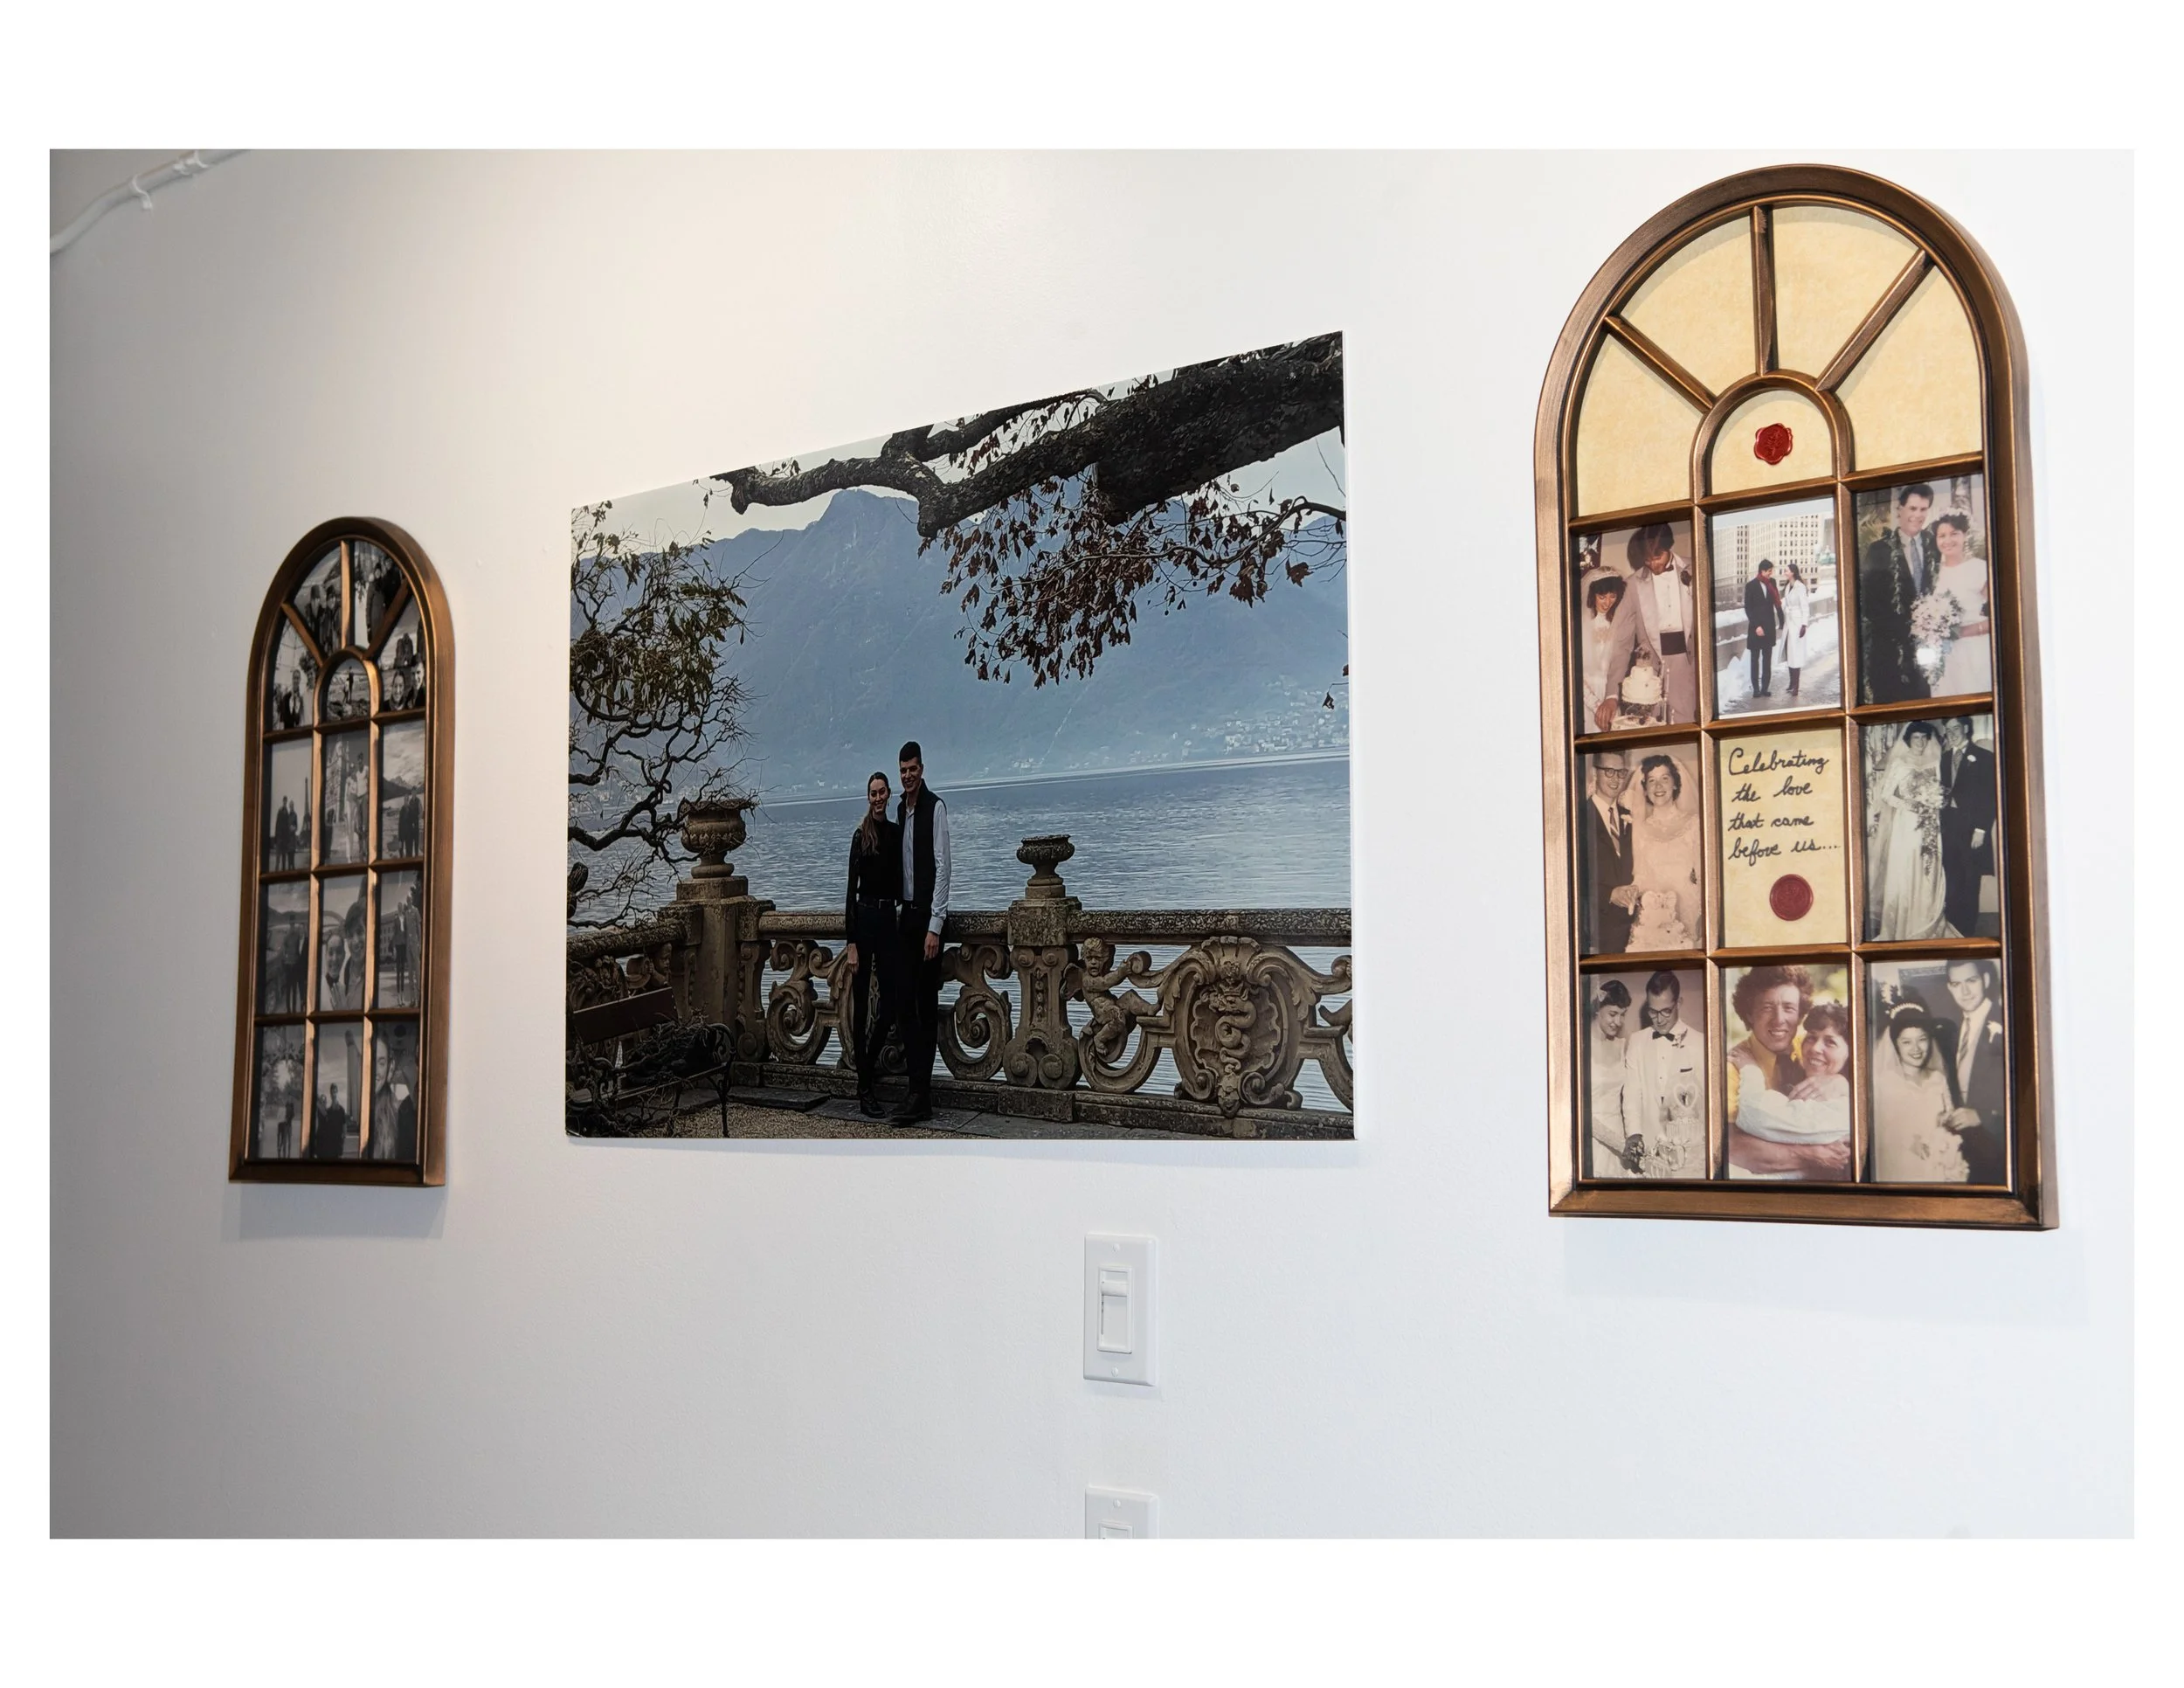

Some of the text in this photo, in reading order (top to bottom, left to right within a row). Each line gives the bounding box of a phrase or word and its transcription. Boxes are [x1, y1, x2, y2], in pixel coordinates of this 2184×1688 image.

[1728, 747, 1829, 776] Celebrating
[1731, 775, 1813, 802] the love
[1728, 812, 1814, 831] that came
[1728, 837, 1781, 867] before
